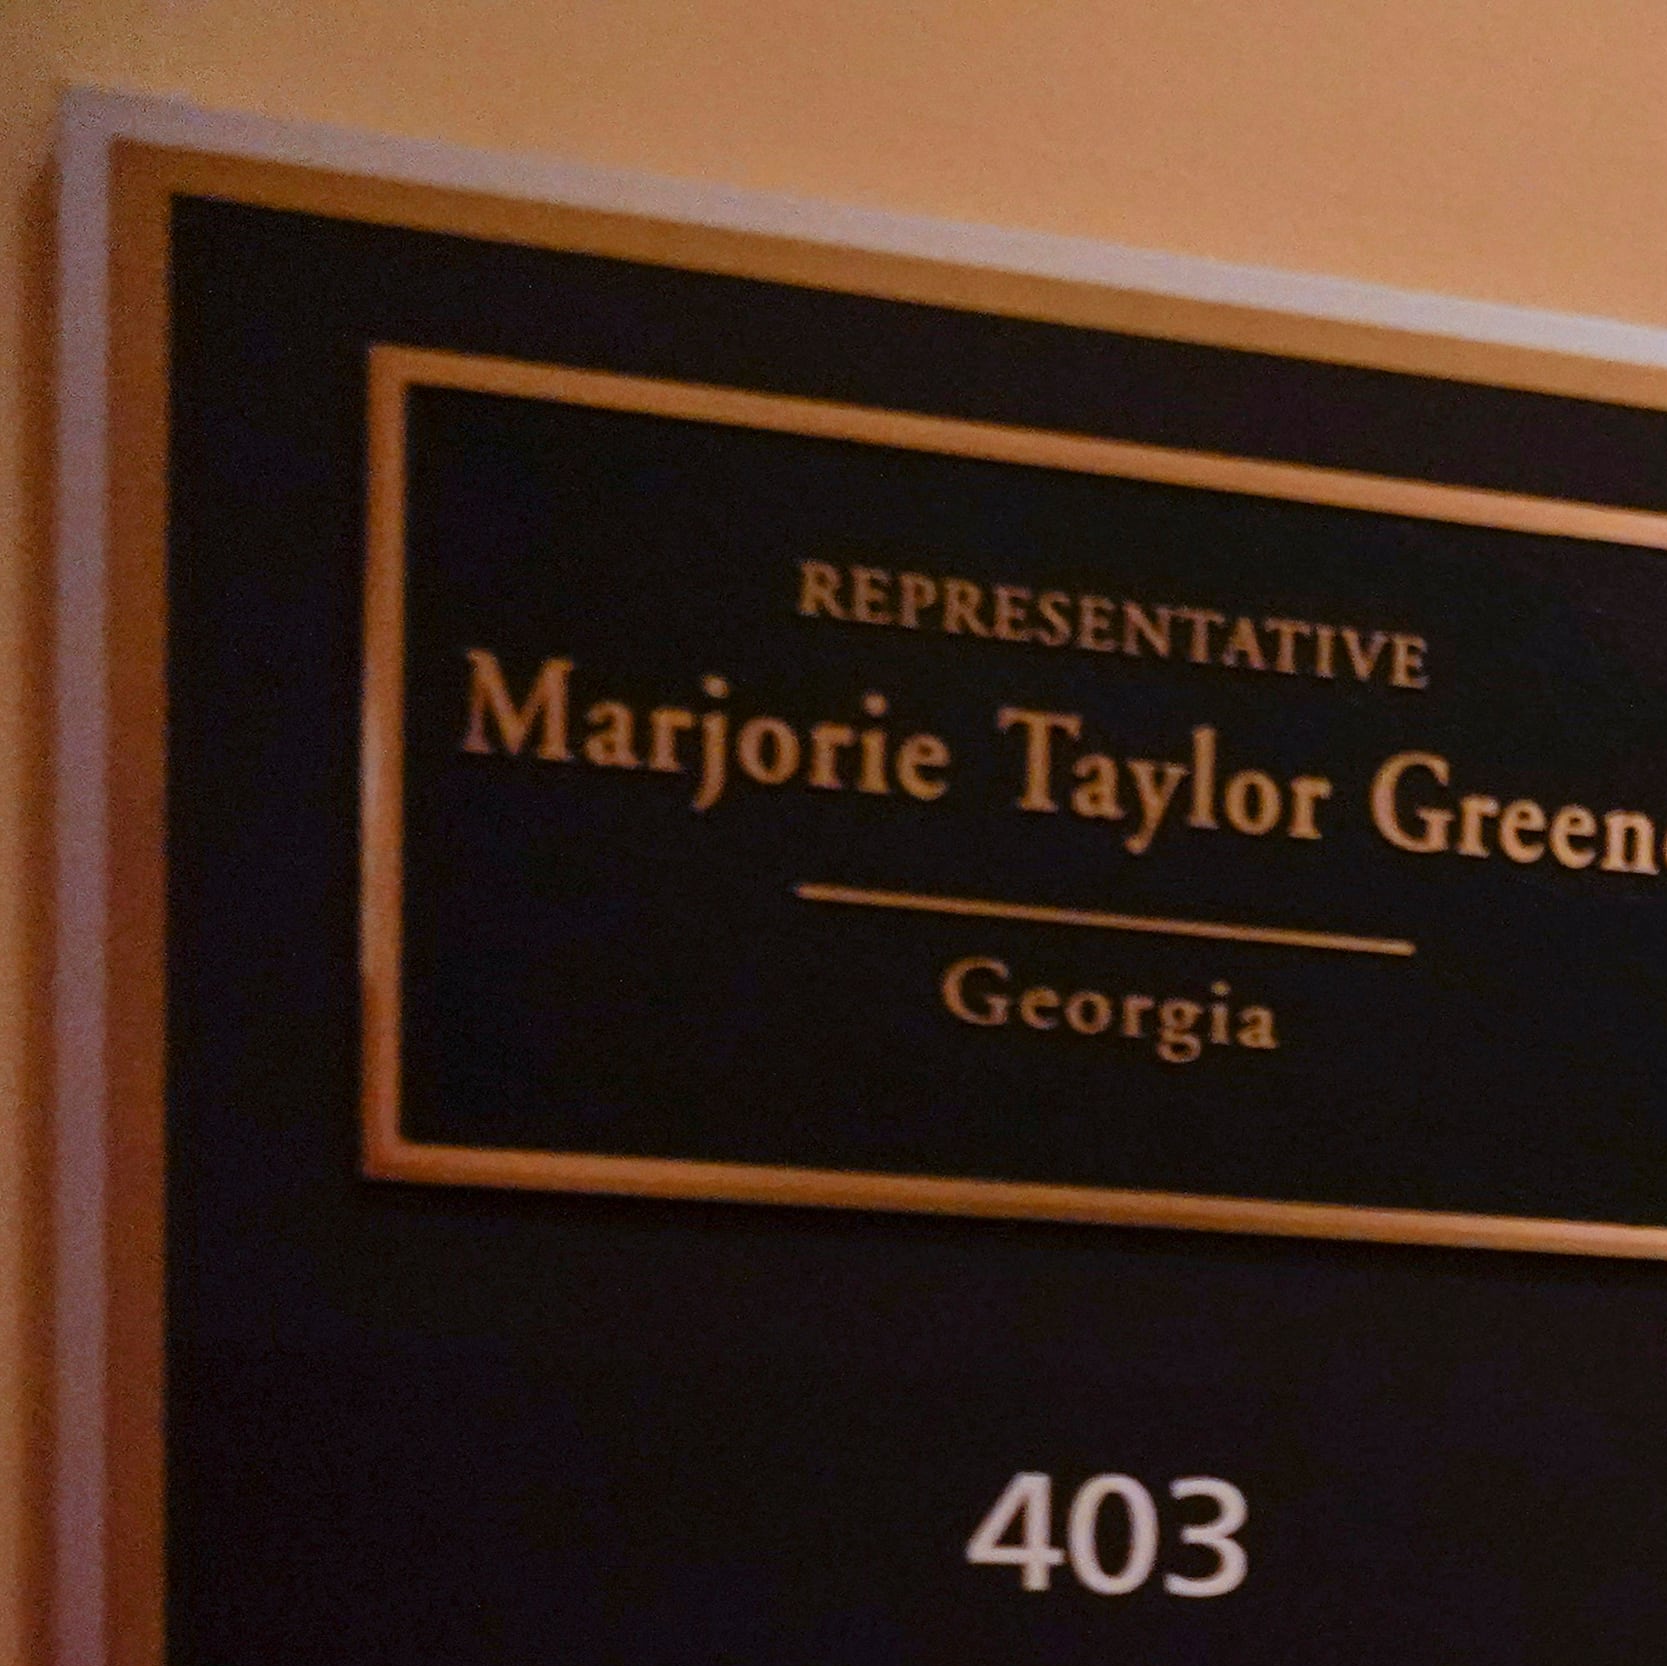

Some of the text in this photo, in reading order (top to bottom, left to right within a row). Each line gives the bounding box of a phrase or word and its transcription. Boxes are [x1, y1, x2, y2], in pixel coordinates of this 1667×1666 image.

[800, 557, 1430, 689] REPRESENTATIVE
[461, 650, 949, 809] Marjorie
[998, 709, 1332, 853] Taylor
[940, 956, 1279, 1063] Georgia
[965, 1471, 1248, 1598] 403
